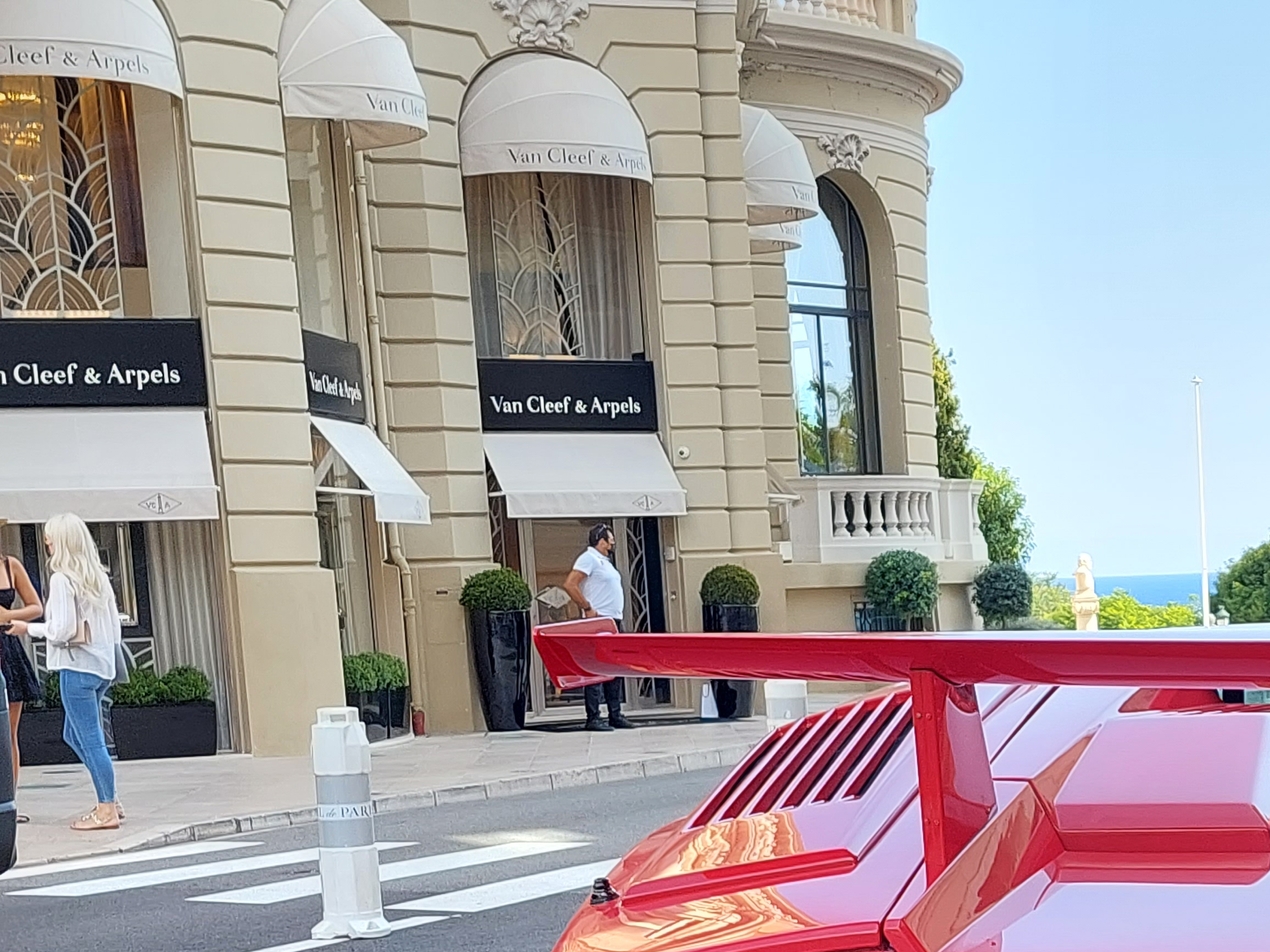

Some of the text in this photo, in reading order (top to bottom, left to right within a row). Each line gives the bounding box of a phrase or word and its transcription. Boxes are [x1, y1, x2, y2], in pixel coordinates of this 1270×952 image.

[62, 51, 78, 67] &
[87, 49, 149, 77] Arpels
[366, 92, 398, 113] Van
[508, 147, 647, 174] Van Cleef & Arpels
[13, 363, 79, 385] Cleef
[84, 367, 102, 384] &
[107, 362, 181, 391] Arpels
[309, 370, 323, 393] Van
[322, 374, 338, 397] Cleef
[344, 379, 362, 406] Arpels
[489, 395, 642, 419] Van Cleef & Arpels
